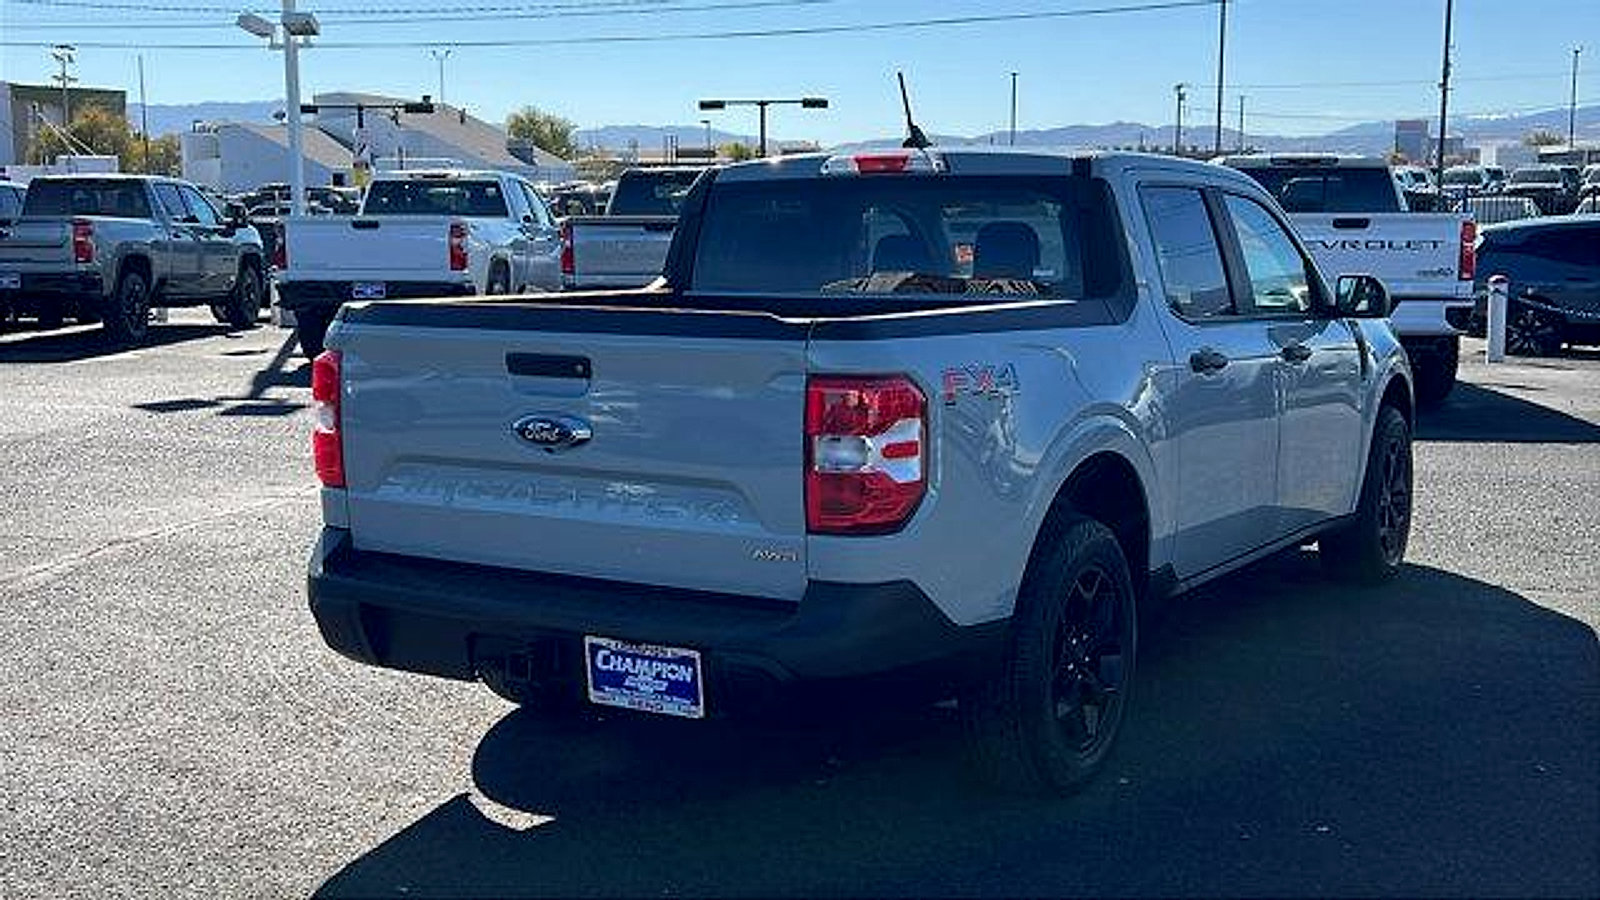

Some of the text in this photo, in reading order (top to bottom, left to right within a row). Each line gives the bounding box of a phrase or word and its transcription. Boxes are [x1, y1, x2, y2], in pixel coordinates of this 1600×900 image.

[943, 362, 1020, 401] FX4
[524, 421, 560, 440] Ford
[595, 649, 693, 682] CHAMPION
